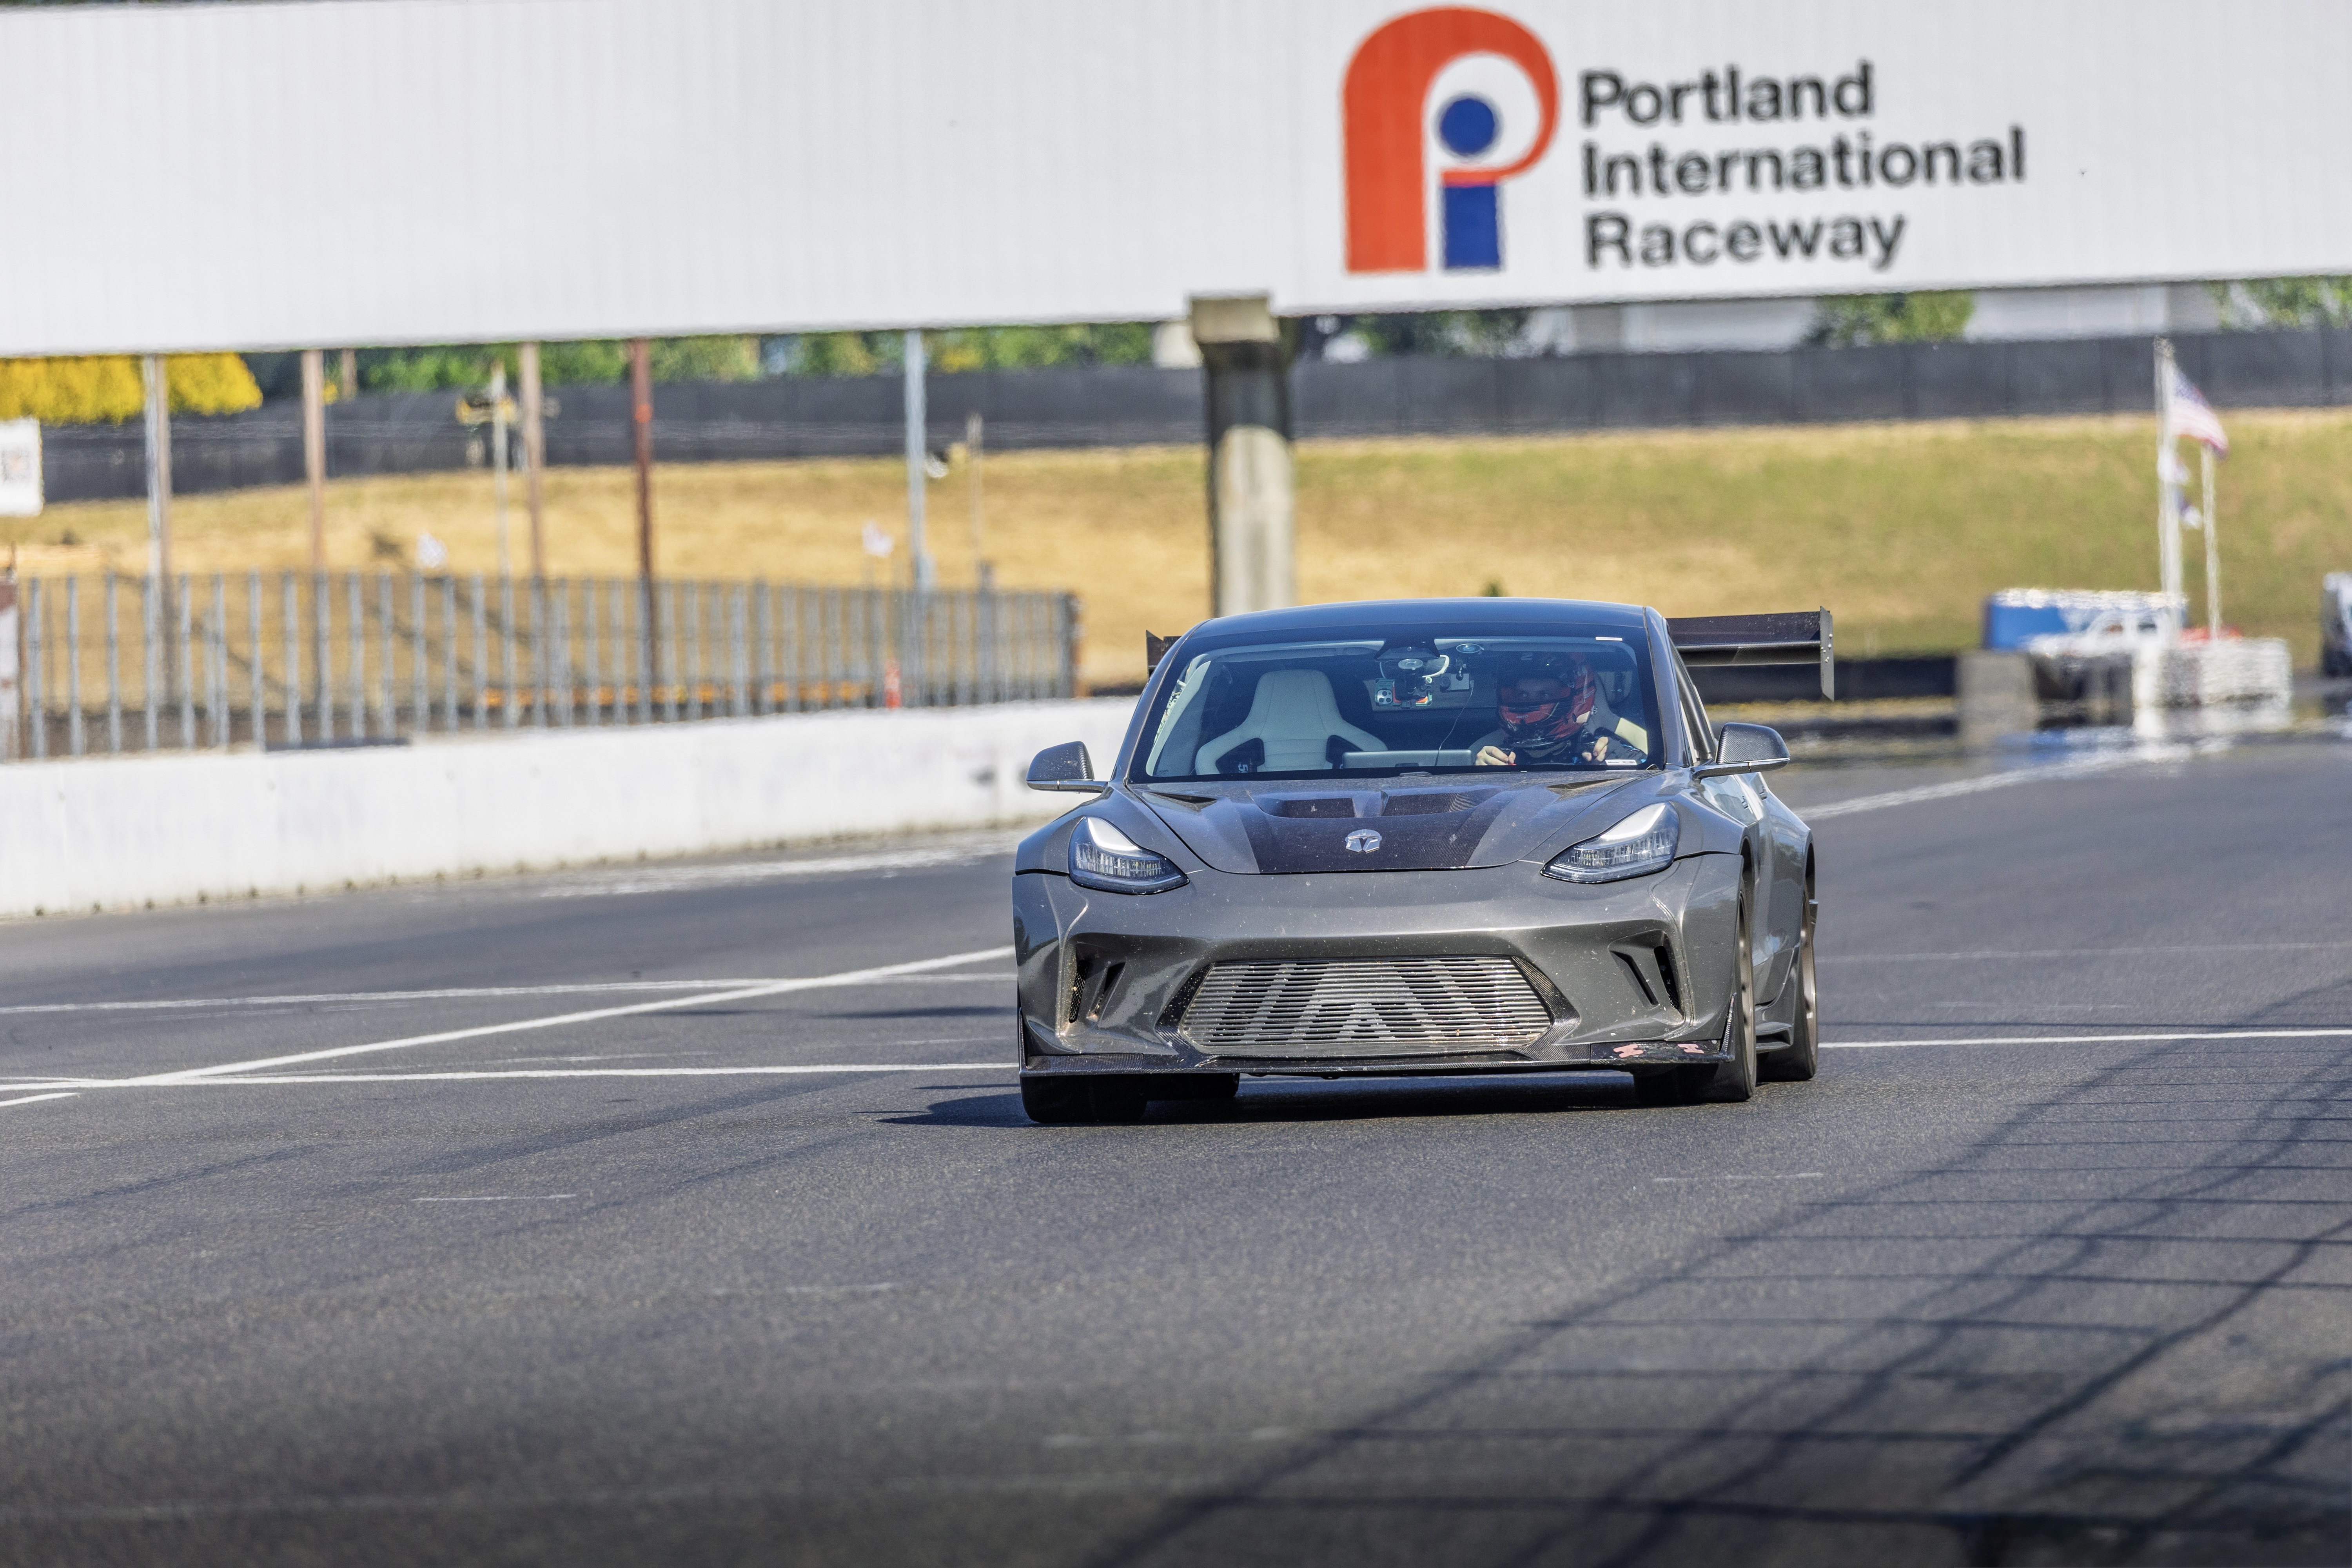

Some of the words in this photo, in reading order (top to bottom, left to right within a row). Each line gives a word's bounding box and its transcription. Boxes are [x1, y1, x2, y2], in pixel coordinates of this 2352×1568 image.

[1581, 63, 1873, 126] Portland
[1584, 127, 2025, 196] International
[1586, 214, 1905, 269] Raceway
